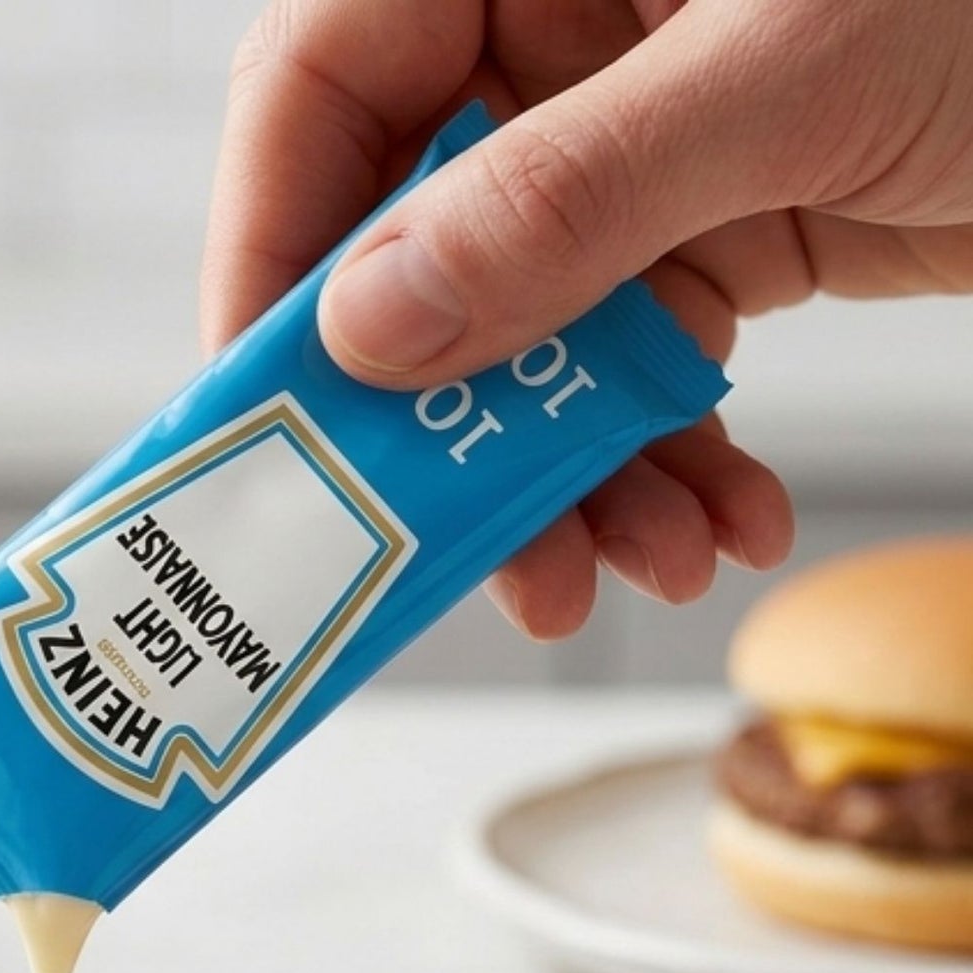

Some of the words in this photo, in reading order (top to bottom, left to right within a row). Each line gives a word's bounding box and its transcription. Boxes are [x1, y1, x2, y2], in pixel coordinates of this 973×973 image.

[112, 597, 203, 688] LIGHT
[115, 513, 281, 693] MAYONNAISE
[39, 623, 162, 757] HEINZ
